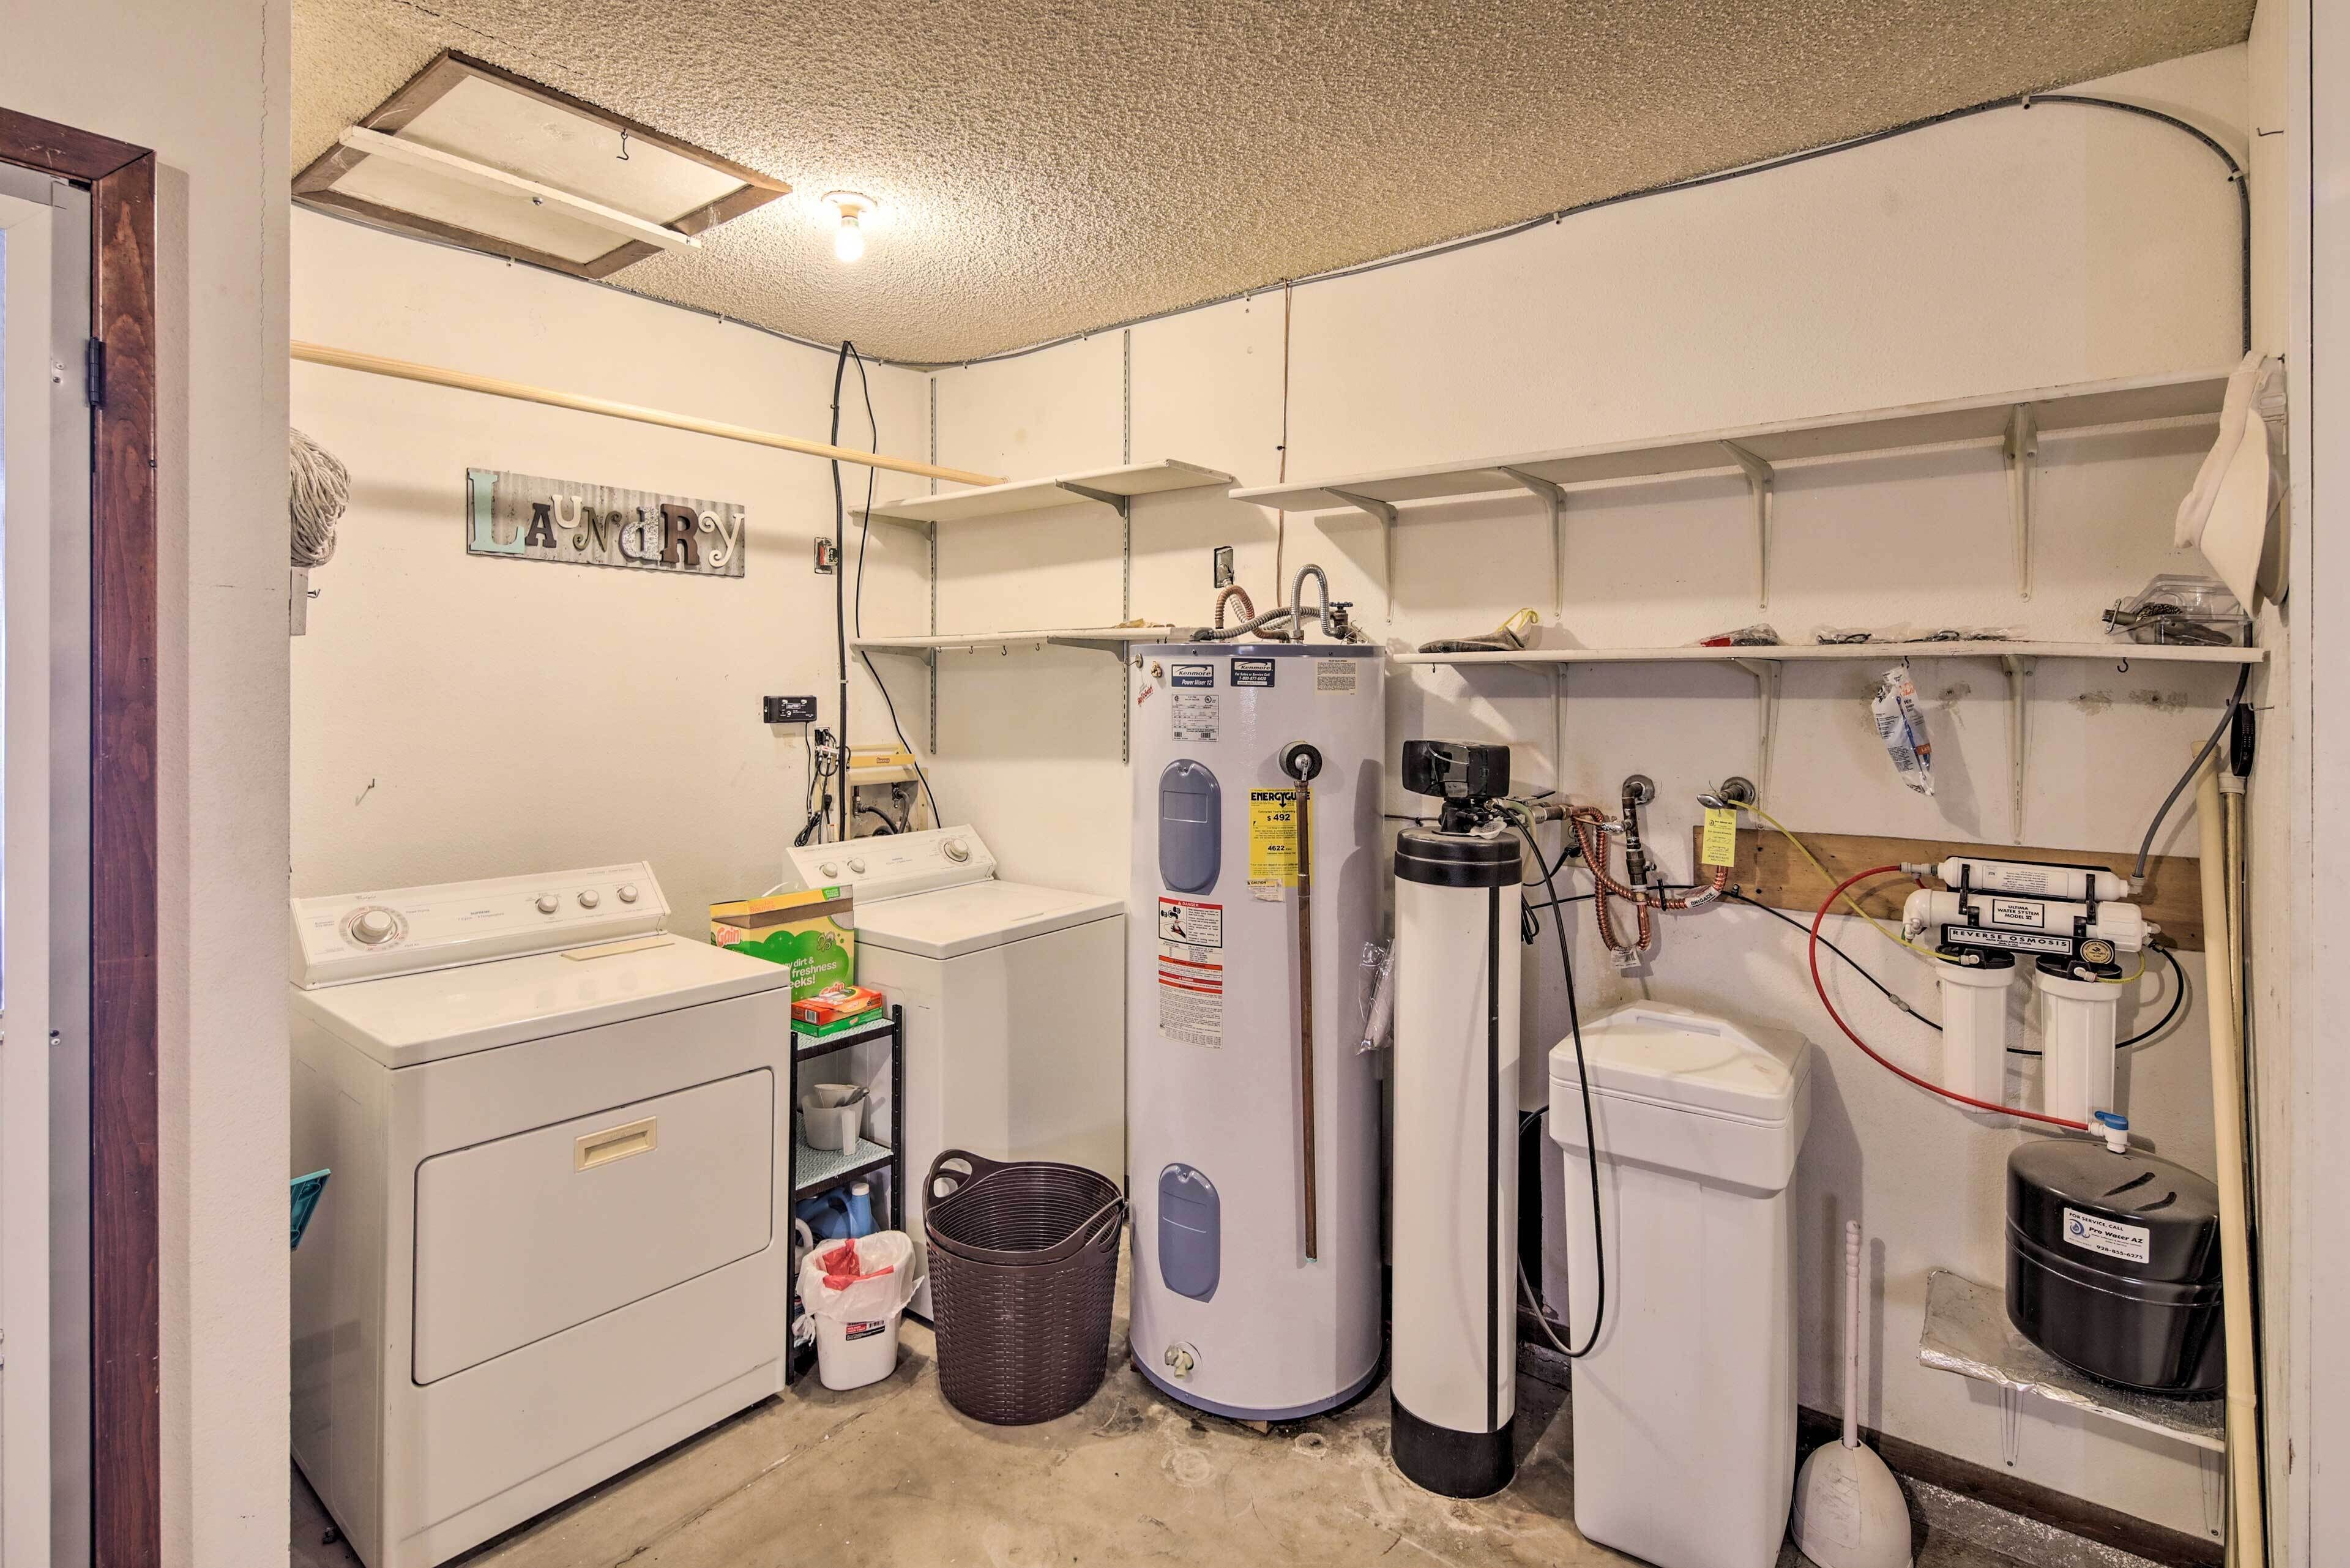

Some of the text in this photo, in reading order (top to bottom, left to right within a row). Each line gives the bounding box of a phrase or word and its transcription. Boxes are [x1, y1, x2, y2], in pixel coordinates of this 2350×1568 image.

[1691, 892, 1714, 906] BRIGADE
[717, 927, 742, 947] Gain
[1953, 930, 2067, 947] REVERSE OSMOSIS
[792, 961, 837, 978] freshness
[794, 958, 807, 967] dirt
[789, 974, 816, 989] eeks!
[2082, 1217, 2107, 1227] SERVICE,
[2105, 1231, 2130, 1241] Water
[2096, 1245, 2143, 1260] 928-855-6275
